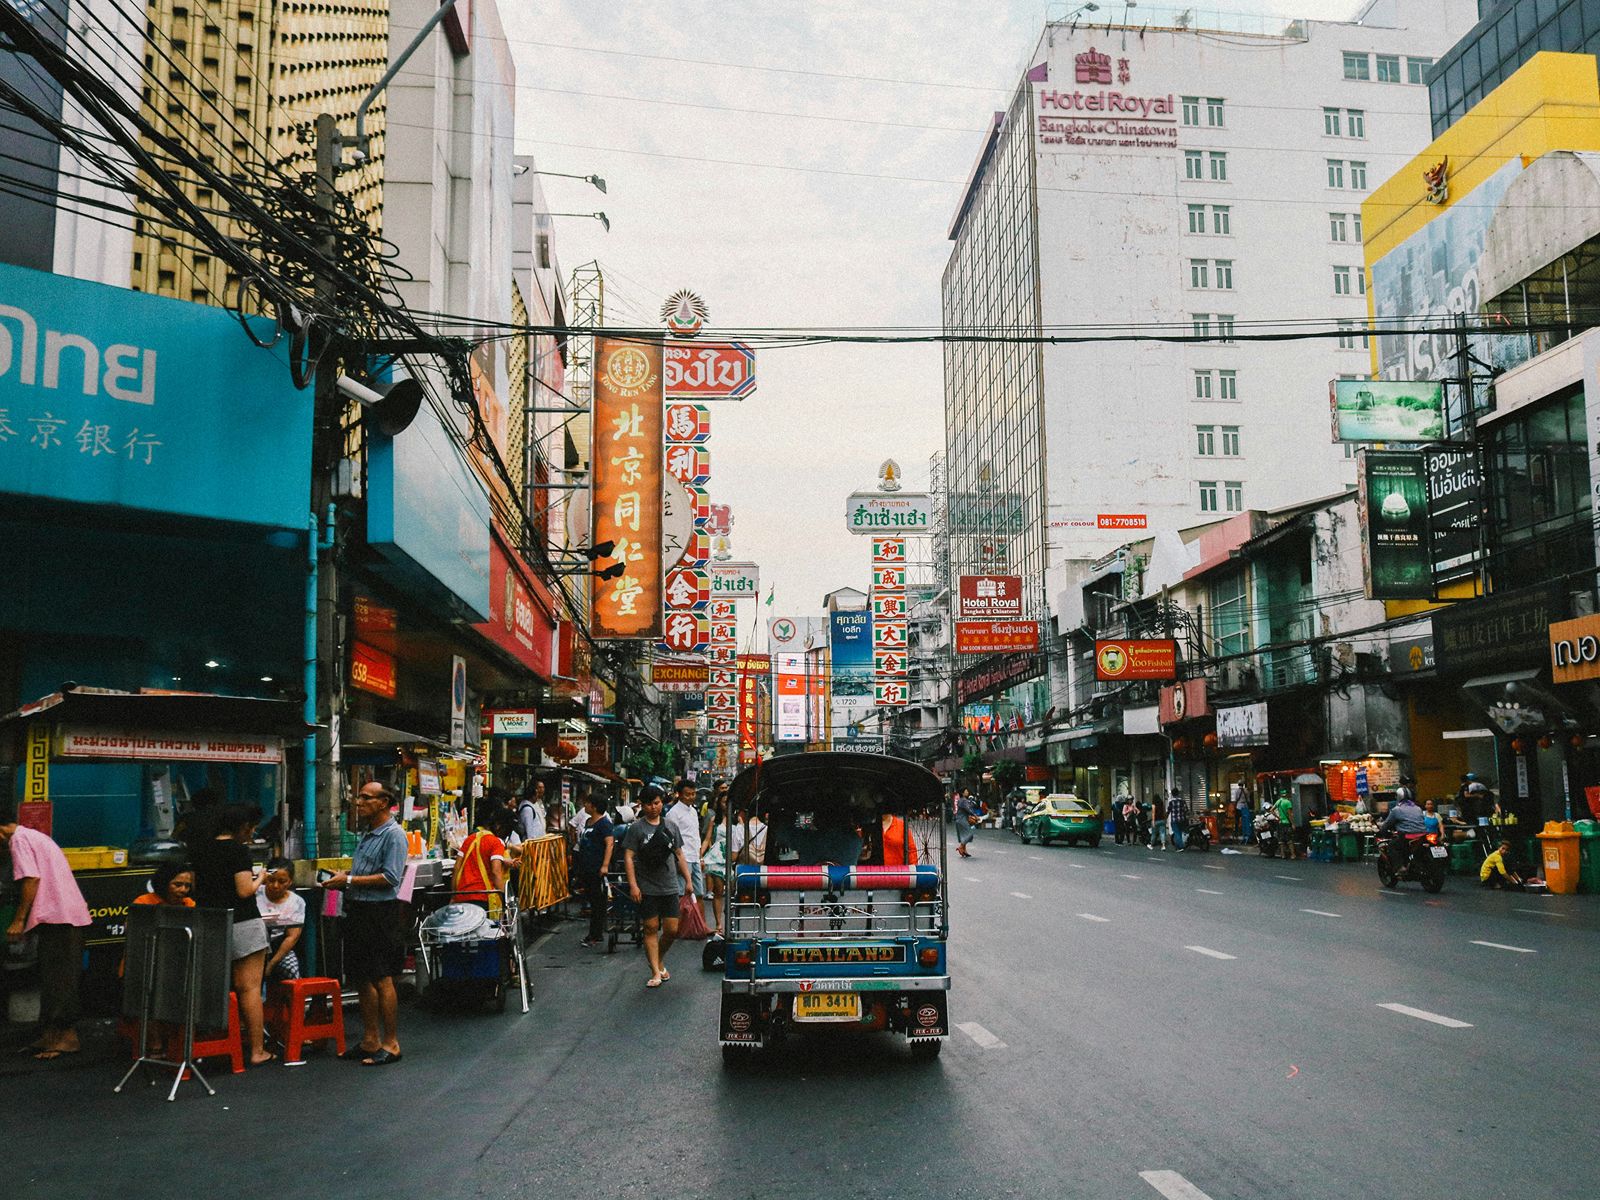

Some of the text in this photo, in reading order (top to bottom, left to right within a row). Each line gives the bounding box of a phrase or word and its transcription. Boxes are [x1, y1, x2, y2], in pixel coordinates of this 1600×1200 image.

[1040, 89, 1174, 117] Hotel Royal
[1038, 118, 1178, 136] Bangkok Chinatown
[610, 402, 645, 617] 北京同仁堂
[962, 597, 1019, 609] Hotel Royal
[881, 541, 900, 702] 和成興大金行
[352, 661, 368, 682] GSB
[654, 668, 709, 680] EXCHANGE
[684, 693, 704, 701] UOB
[841, 698, 857, 706] 1720
[778, 947, 896, 963] THAILAND
[826, 994, 856, 1008] 3411
